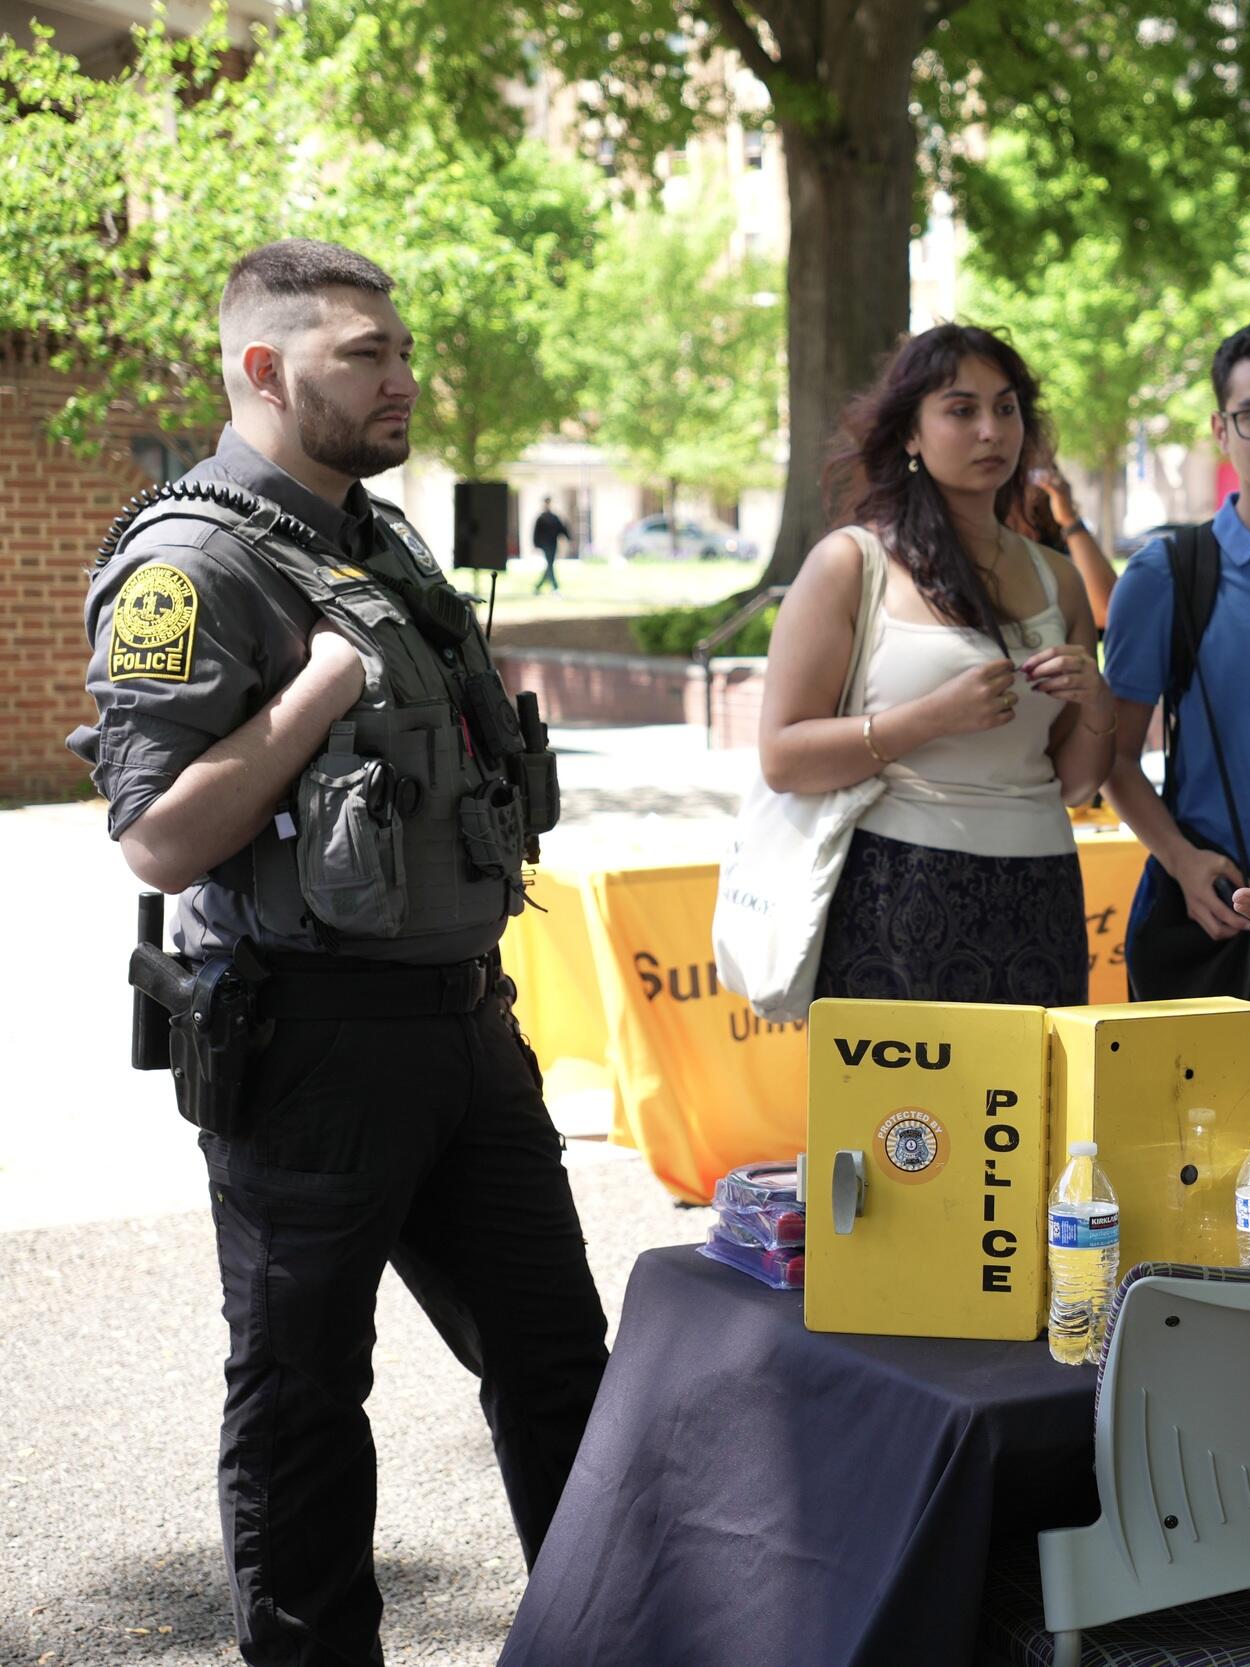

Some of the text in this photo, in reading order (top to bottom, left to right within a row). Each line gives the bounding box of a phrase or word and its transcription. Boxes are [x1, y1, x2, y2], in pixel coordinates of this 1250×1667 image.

[122, 567, 192, 600] COMMONWEALTH
[143, 606, 193, 645] UNIVERSITY
[112, 652, 183, 673] POLICE
[834, 1038, 952, 1070] VCU
[877, 1110, 930, 1139] PROTECTED
[929, 1119, 943, 1134] BY
[981, 1089, 1020, 1293] POLICE
